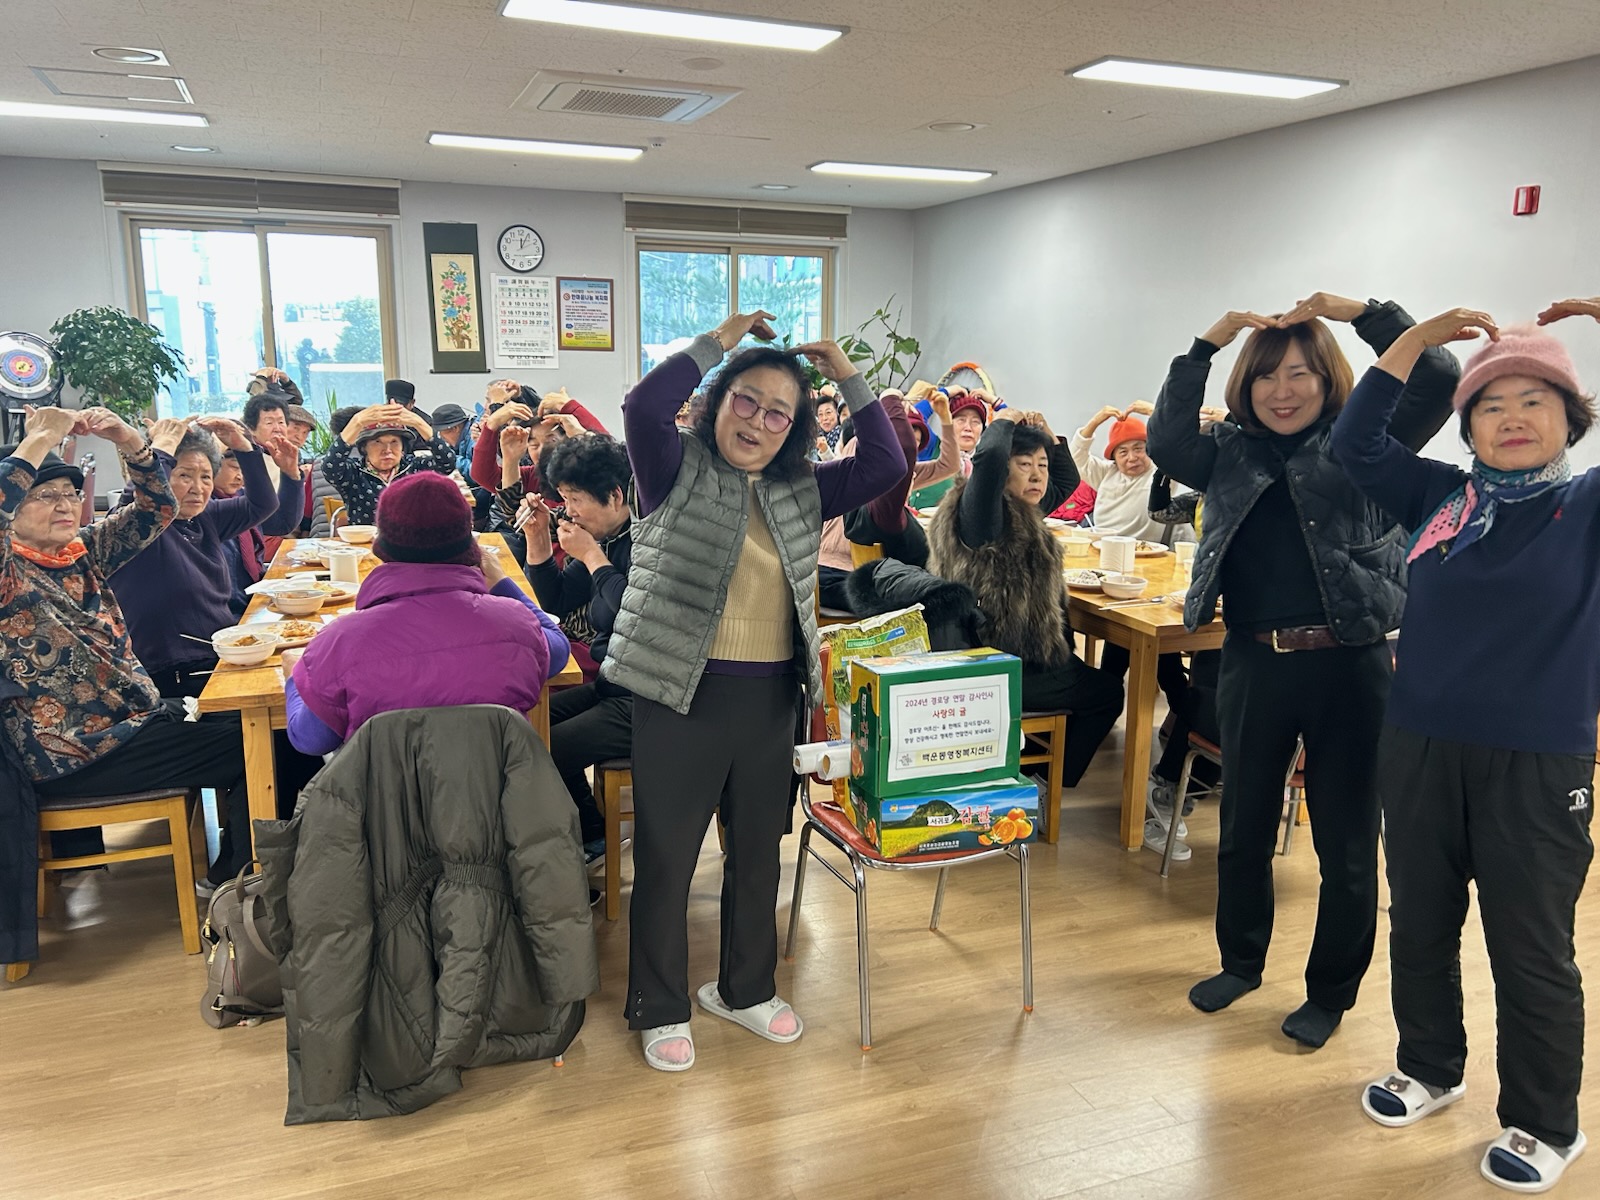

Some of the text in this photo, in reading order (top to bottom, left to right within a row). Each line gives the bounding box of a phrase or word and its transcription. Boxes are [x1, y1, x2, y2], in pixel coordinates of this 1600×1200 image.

[905, 691, 993, 707] 2024년 경로당 연말 감사인사
[932, 707, 966, 718] 사랑의 귤
[922, 745, 993, 762] 백운동행정복지센터
